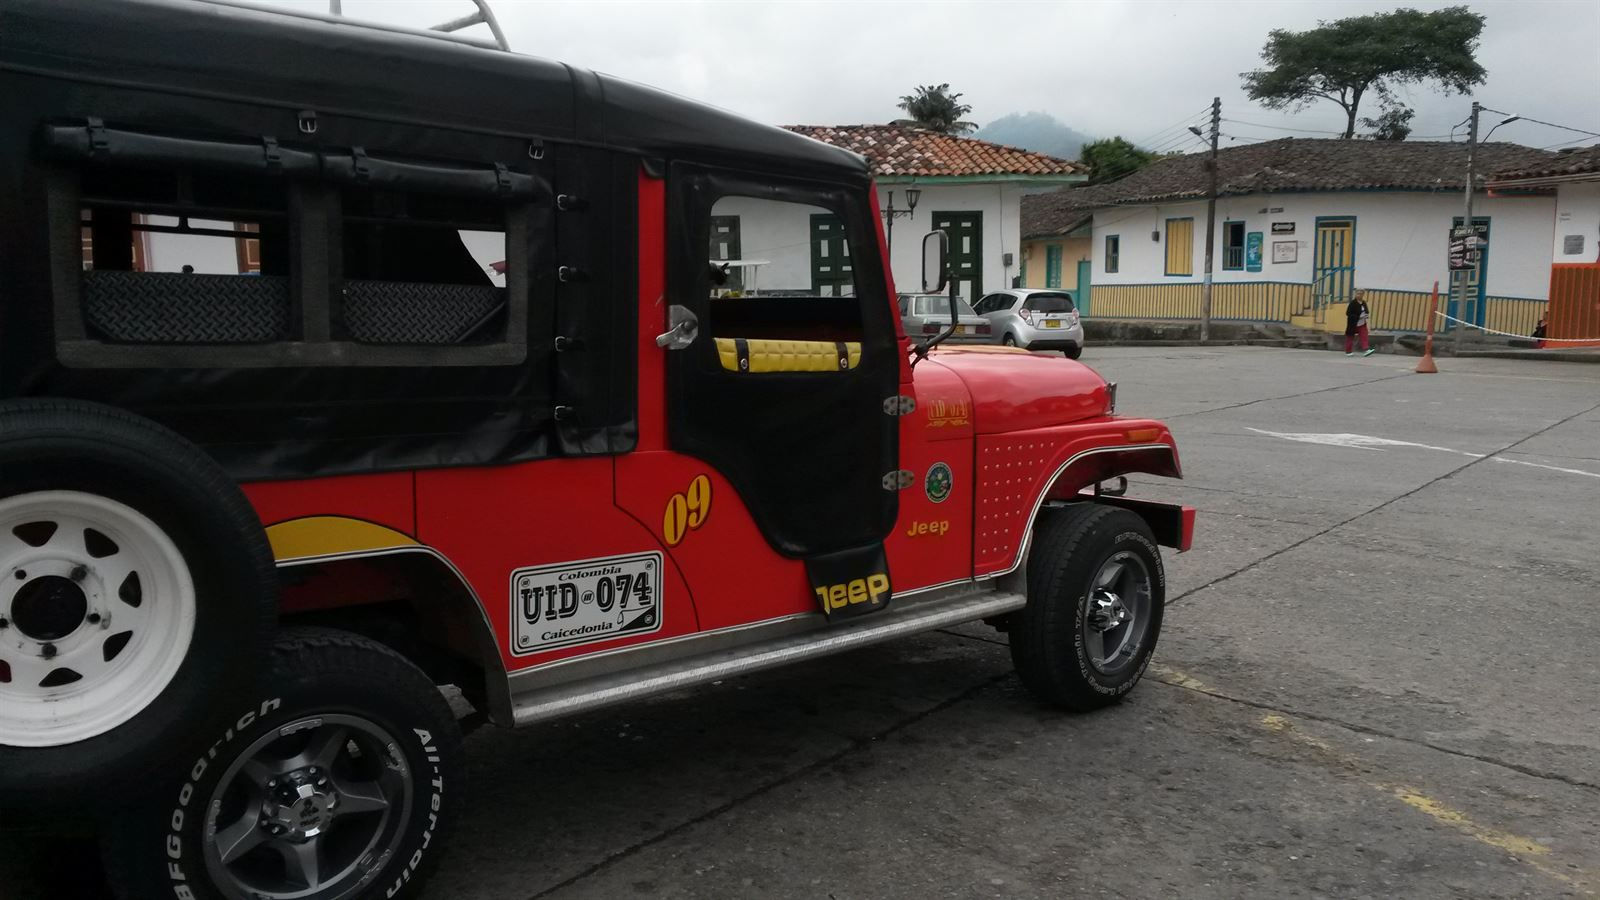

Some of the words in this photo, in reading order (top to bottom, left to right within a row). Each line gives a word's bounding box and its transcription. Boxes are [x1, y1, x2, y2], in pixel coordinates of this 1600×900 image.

[663, 473, 713, 548] 09
[907, 519, 950, 537] Jeep
[521, 582, 579, 625] UID
[596, 572, 652, 613] 074
[558, 566, 622, 582] Colombia
[541, 621, 613, 642] Caicedonia
[166, 697, 281, 900] BFGoodrich
[386, 727, 444, 899] All-Terrain
